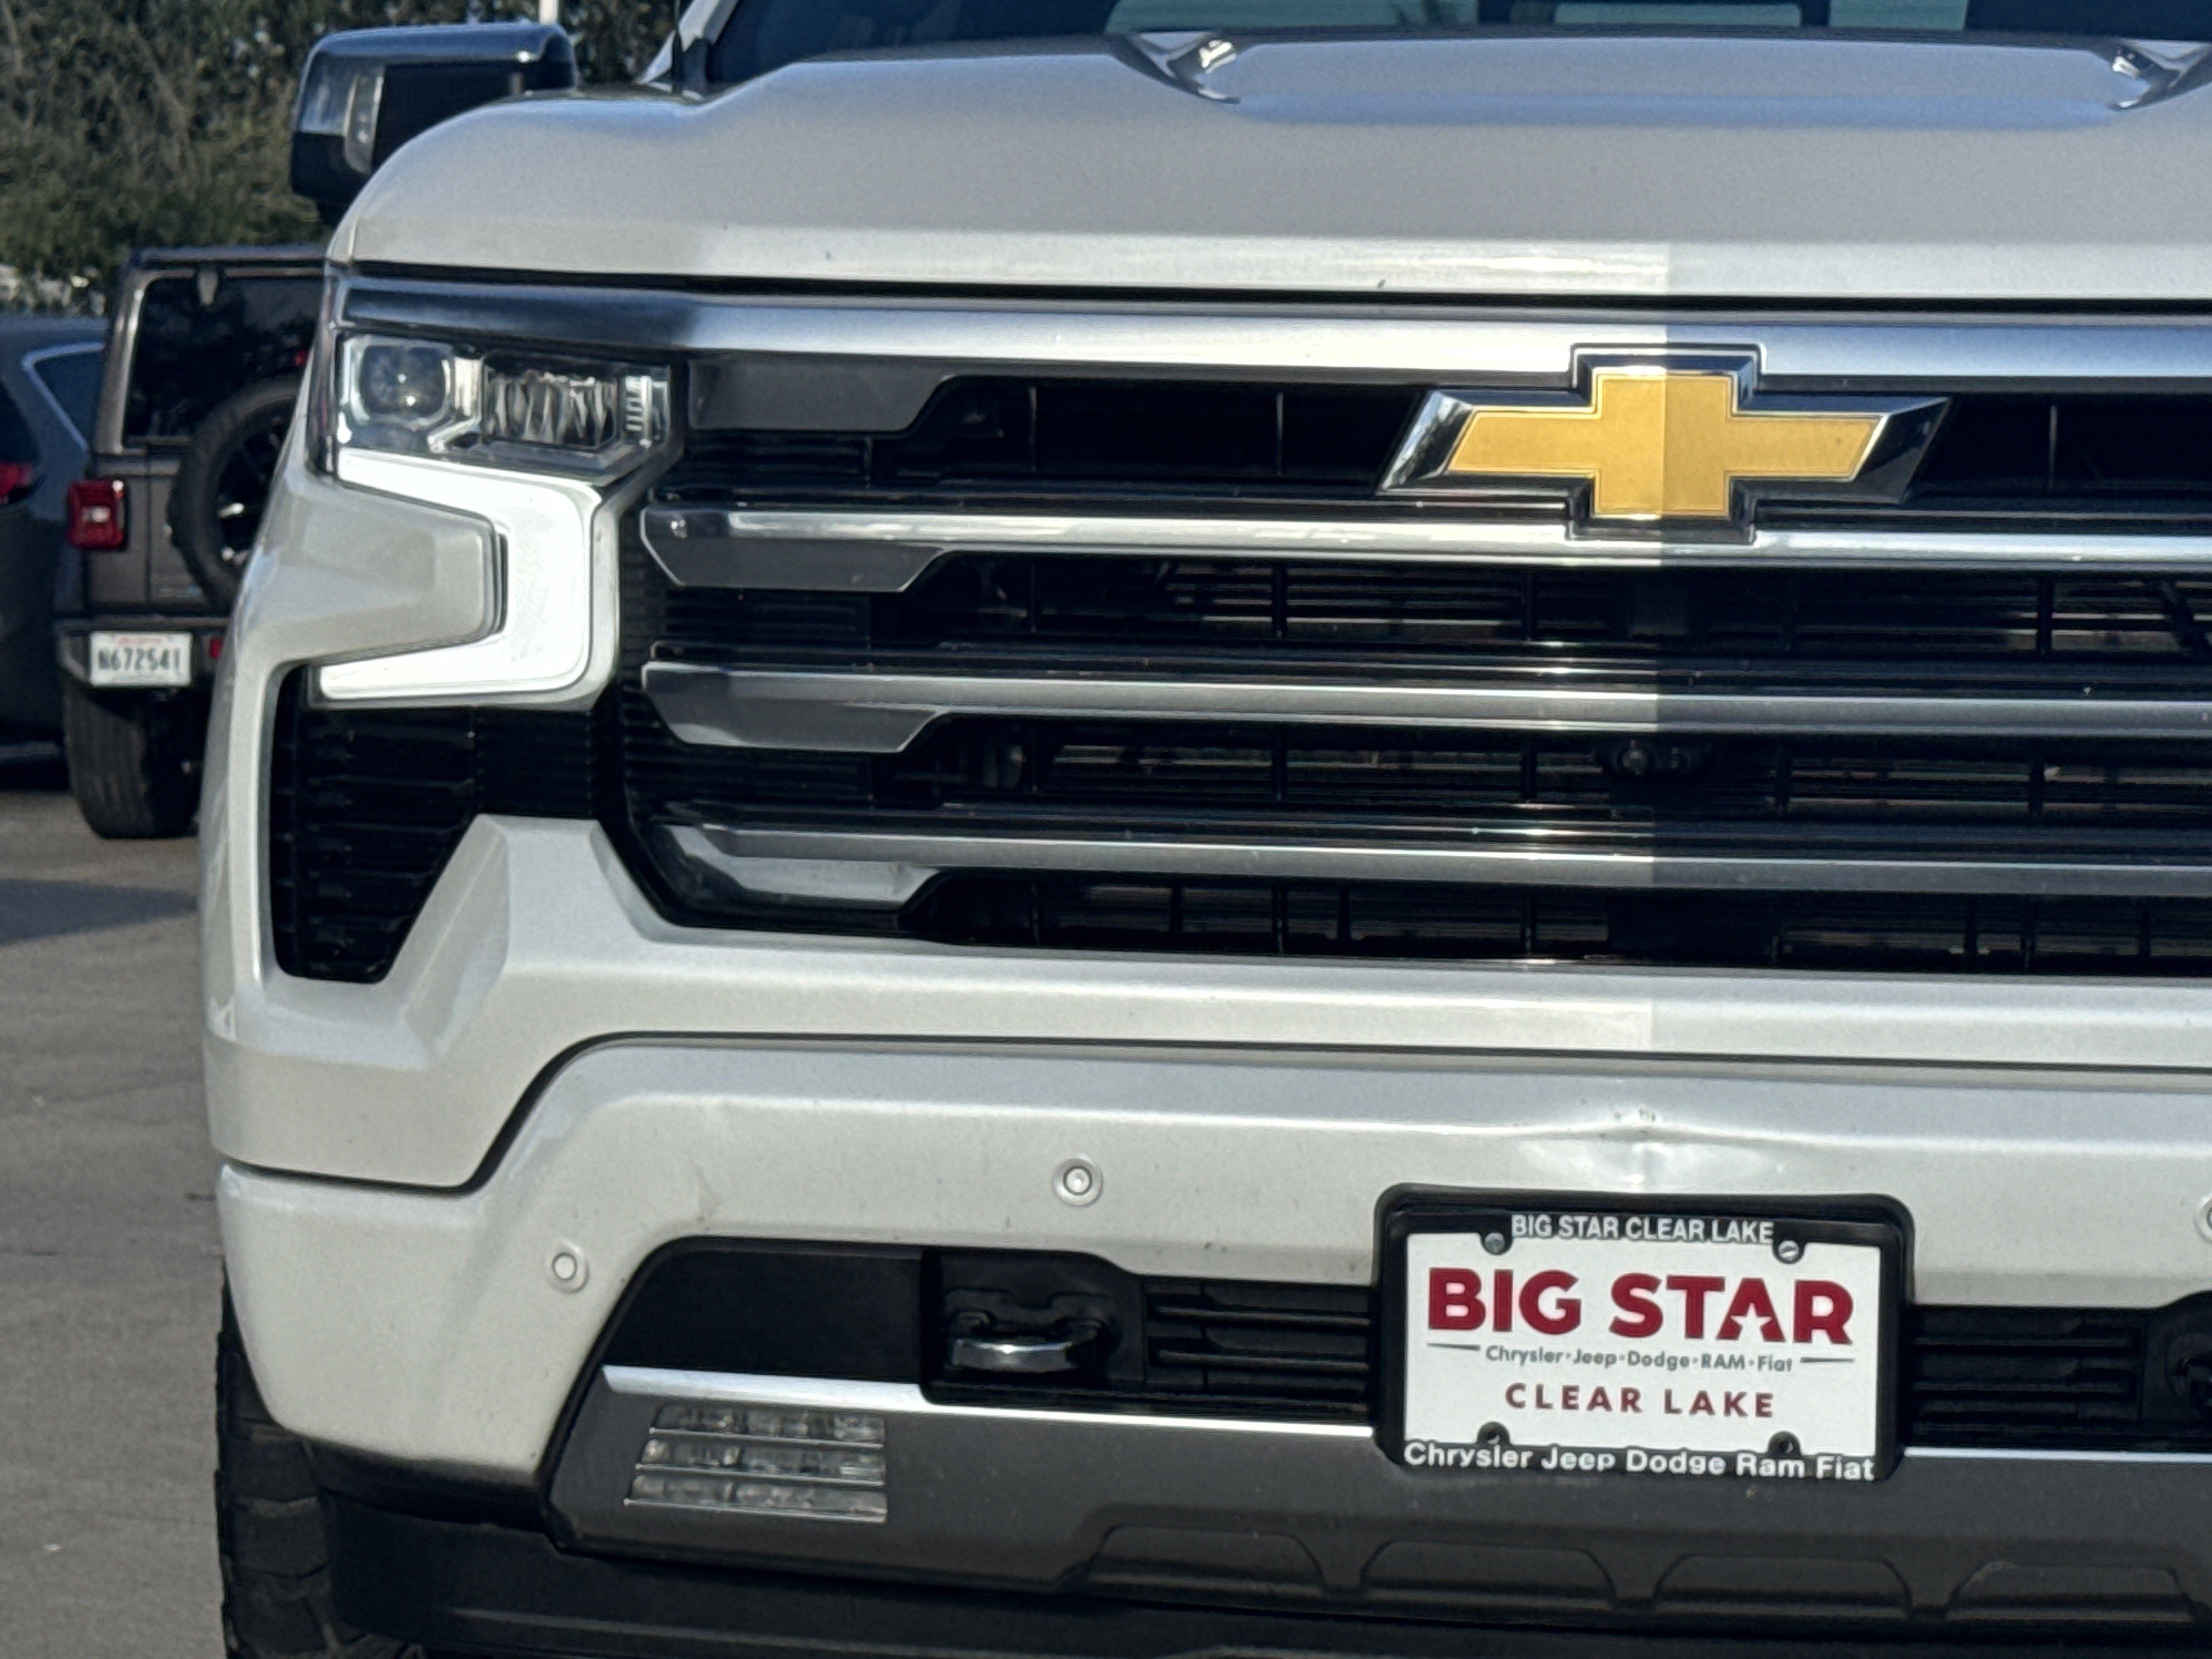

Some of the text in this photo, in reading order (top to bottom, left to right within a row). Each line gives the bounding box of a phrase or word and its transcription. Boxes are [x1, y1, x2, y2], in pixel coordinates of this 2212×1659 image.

[1511, 1214, 1774, 1245] BIG STAR CLEAR LAKE
[1427, 1267, 1854, 1345] BIG STAR
[1504, 1382, 1774, 1418] CLEAR LAKE
[1403, 1442, 1875, 1481] Chrysler Jeep Dodge Ram Fiat
